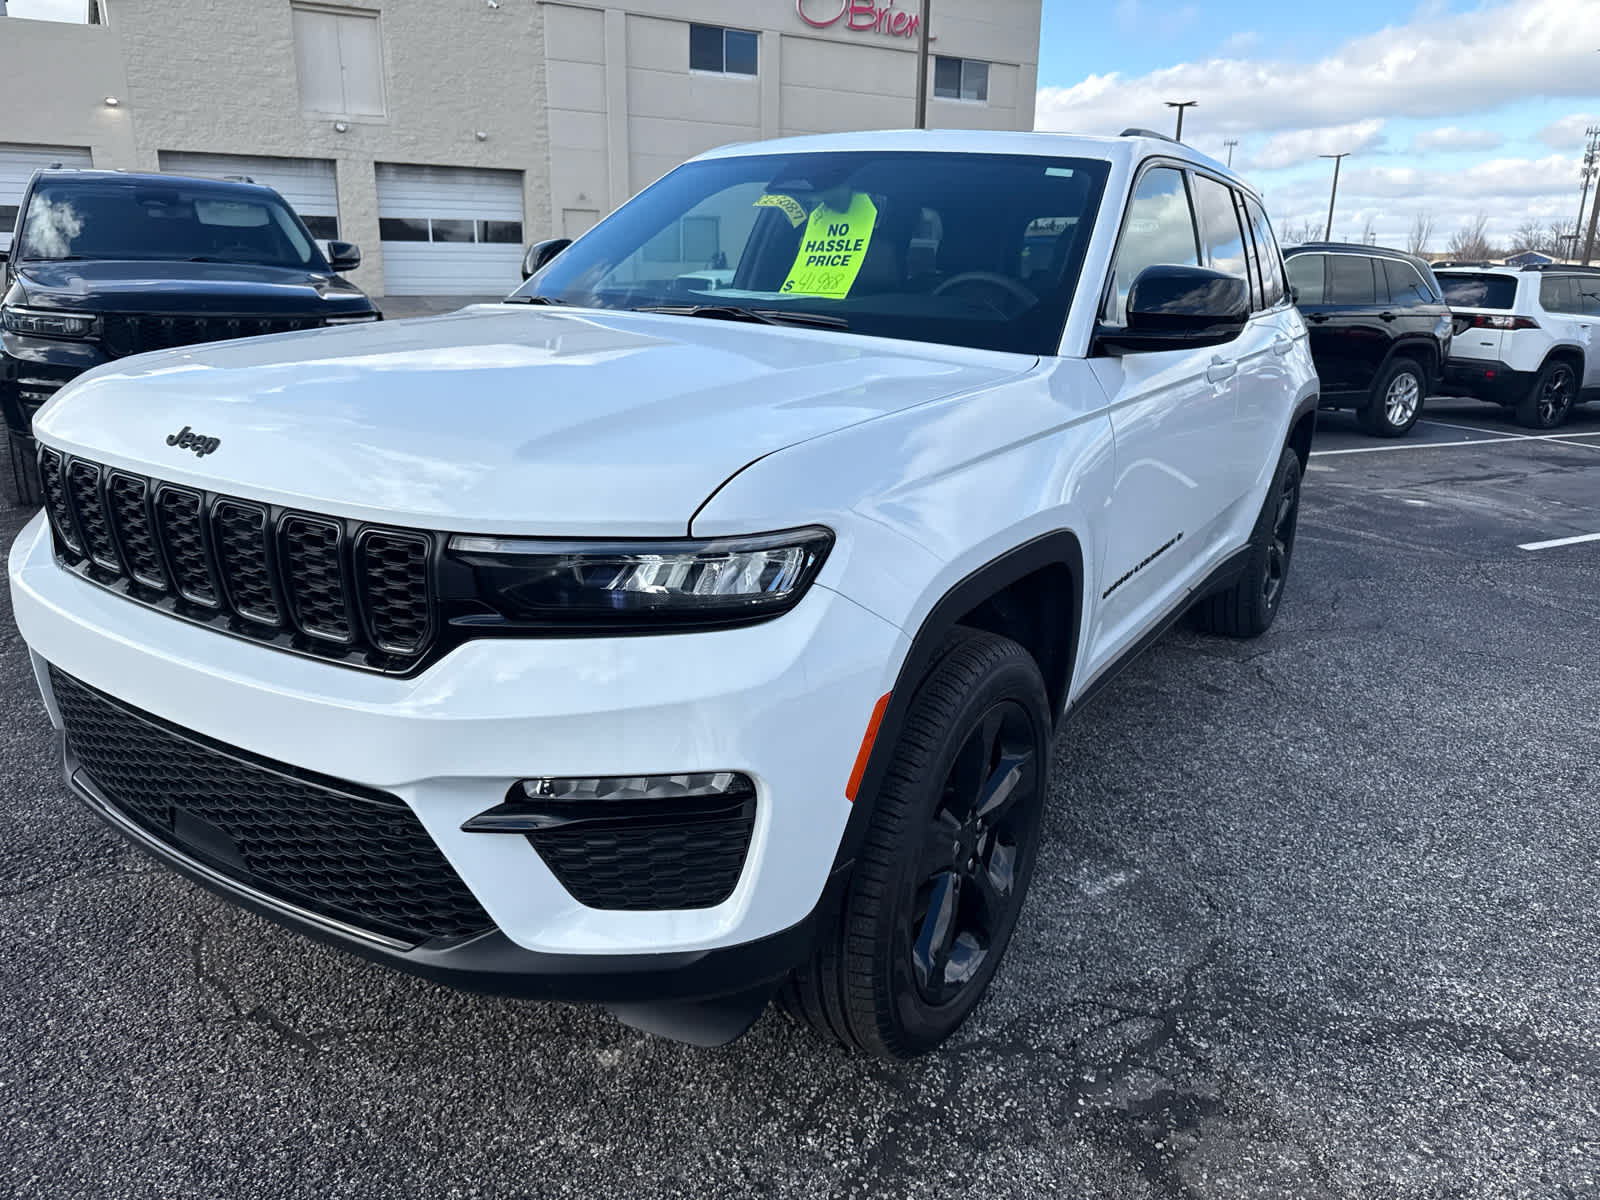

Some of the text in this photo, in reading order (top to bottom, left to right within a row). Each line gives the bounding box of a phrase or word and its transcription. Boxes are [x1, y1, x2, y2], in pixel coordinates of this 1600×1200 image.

[827, 224, 849, 237] NO
[805, 239, 864, 252] HASSLE
[805, 255, 852, 267] PRICE
[166, 425, 221, 458] Jeep
